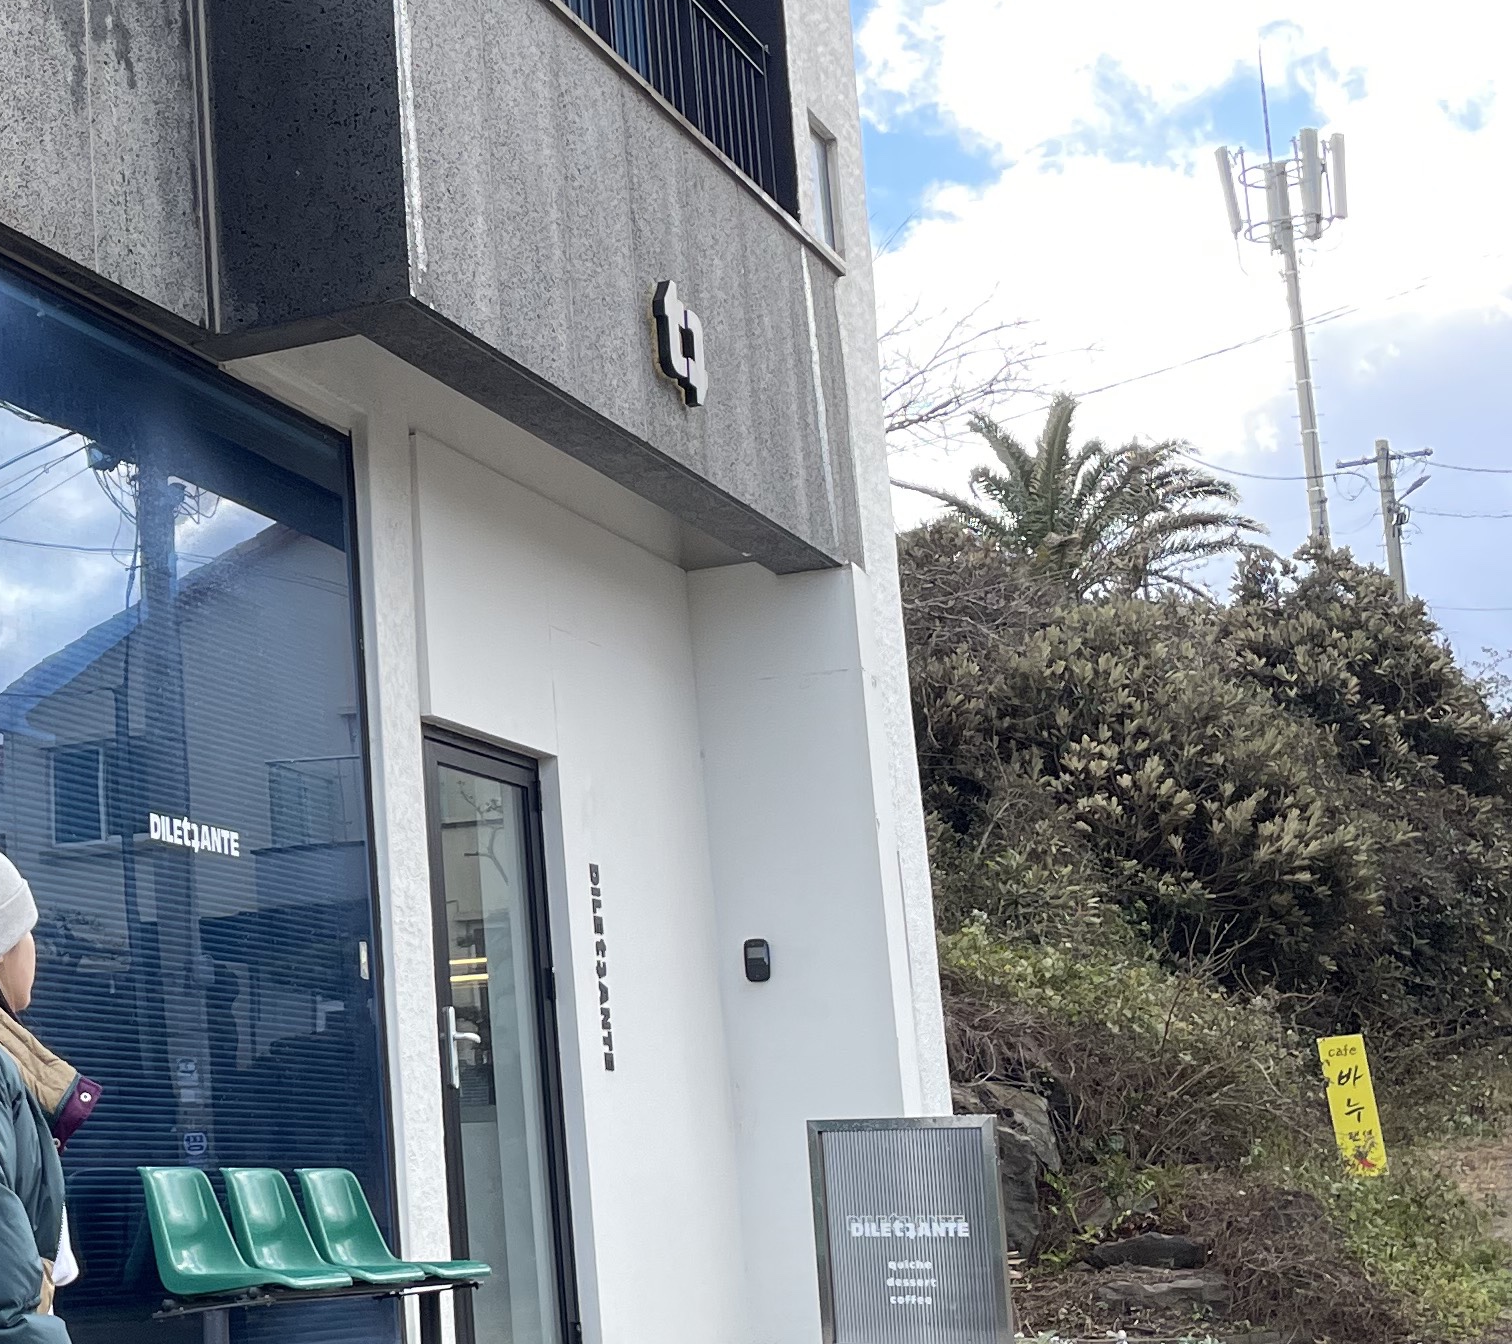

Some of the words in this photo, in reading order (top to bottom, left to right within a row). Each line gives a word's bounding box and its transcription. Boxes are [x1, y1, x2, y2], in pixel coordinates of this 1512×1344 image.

[1328, 1044, 1357, 1058] cafe
[888, 1259, 932, 1270] quiche
[886, 1277, 937, 1288] dessert
[889, 1295, 933, 1305] coffee
